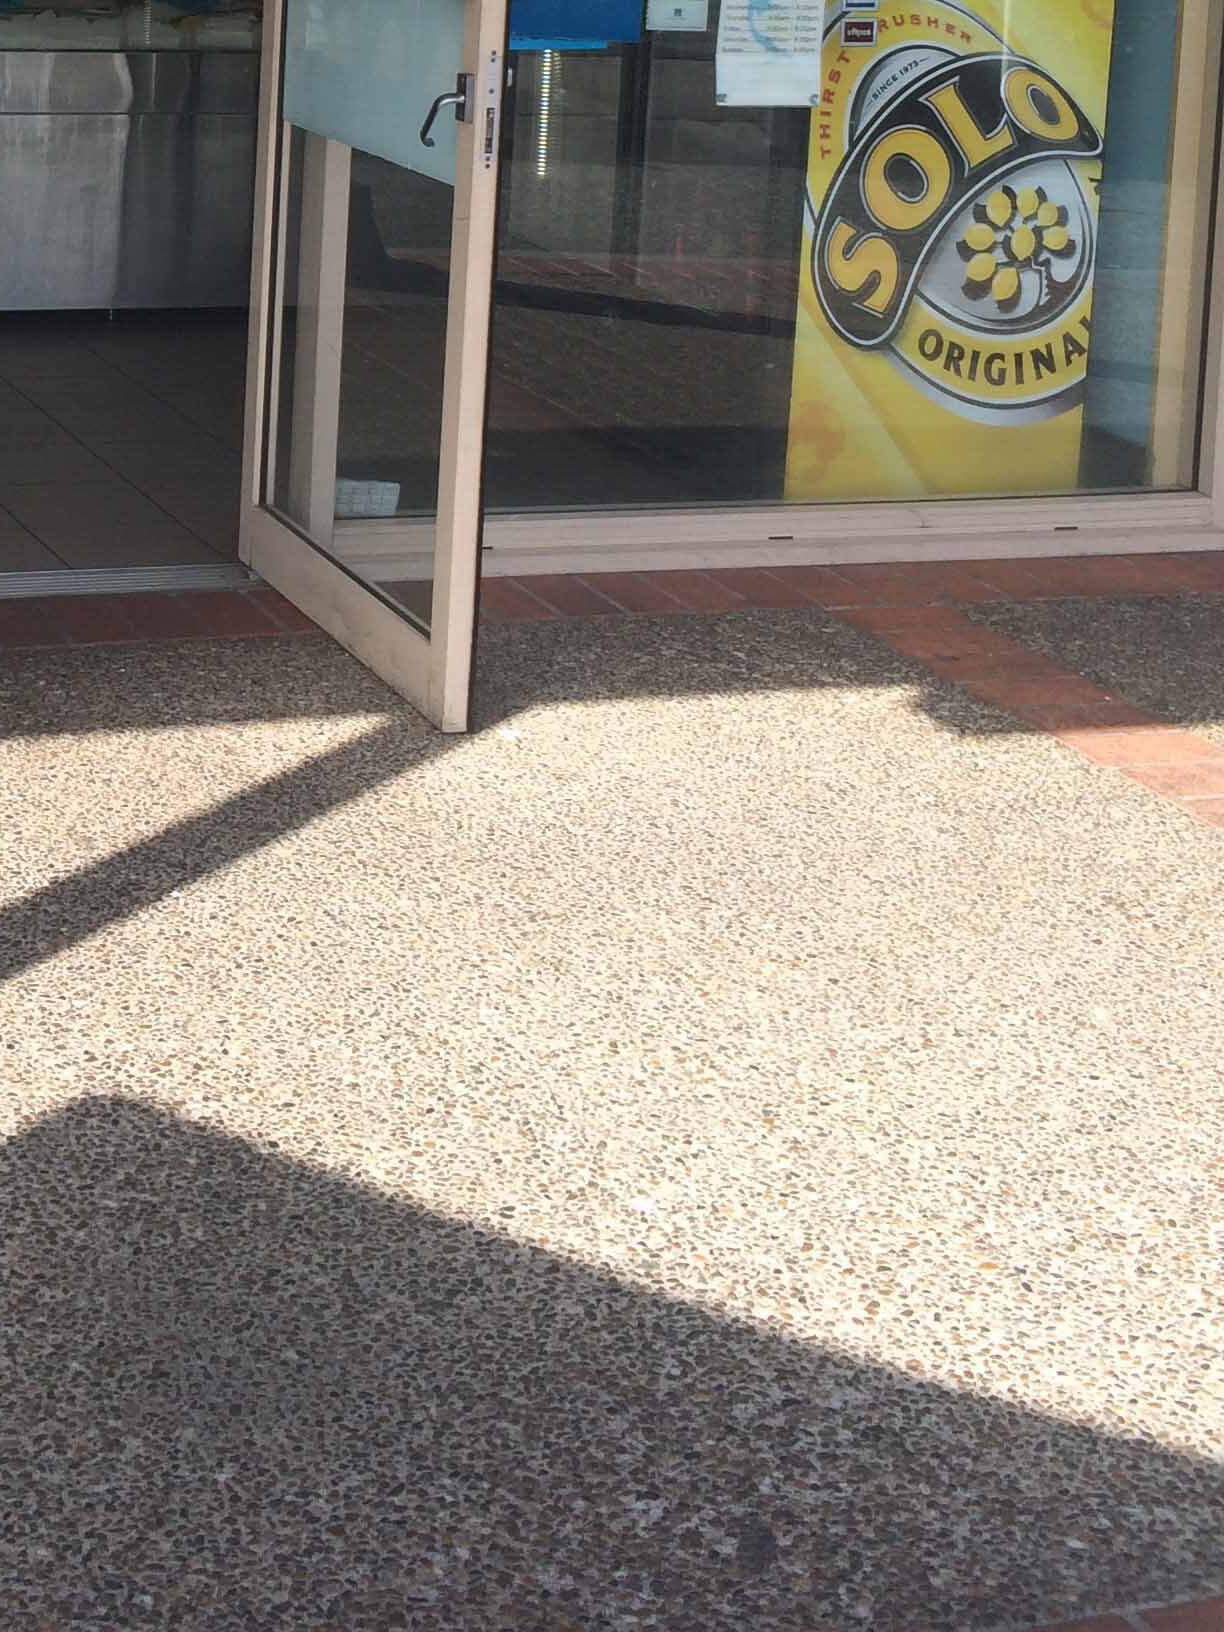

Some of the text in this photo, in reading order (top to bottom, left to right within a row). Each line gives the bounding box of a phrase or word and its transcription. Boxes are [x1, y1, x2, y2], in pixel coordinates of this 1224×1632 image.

[819, 49, 852, 160] THIRST
[877, 13, 973, 44] RUSHER
[871, 74, 899, 101] SINCE
[825, 66, 1080, 319] SOLO
